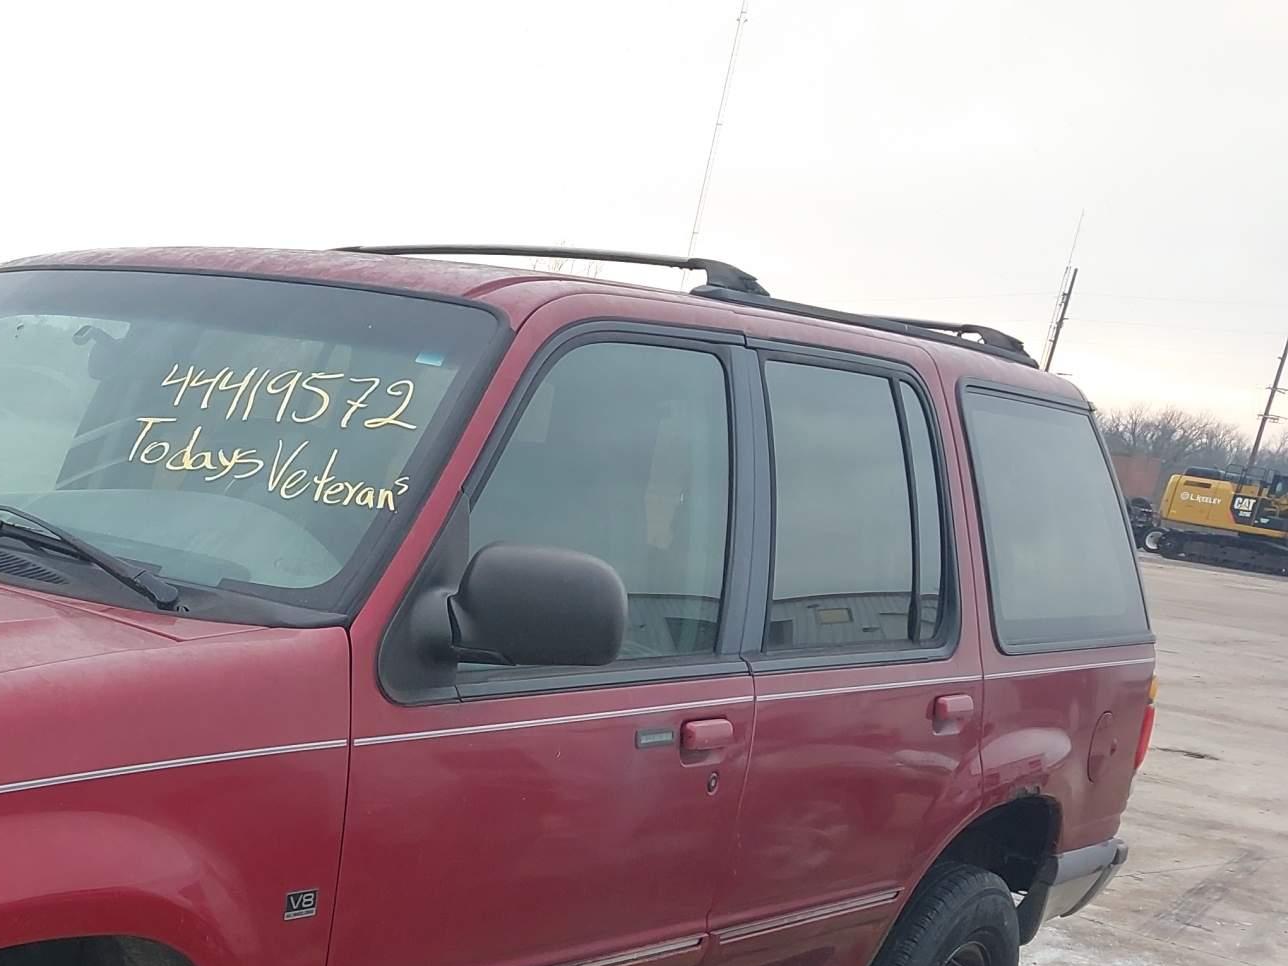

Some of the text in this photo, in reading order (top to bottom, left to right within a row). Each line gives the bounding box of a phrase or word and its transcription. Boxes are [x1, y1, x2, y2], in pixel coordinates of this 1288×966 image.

[161, 363, 416, 430] 44419572
[128, 417, 264, 481] Todays
[1233, 496, 1256, 511] CAT
[290, 893, 314, 909] V8
